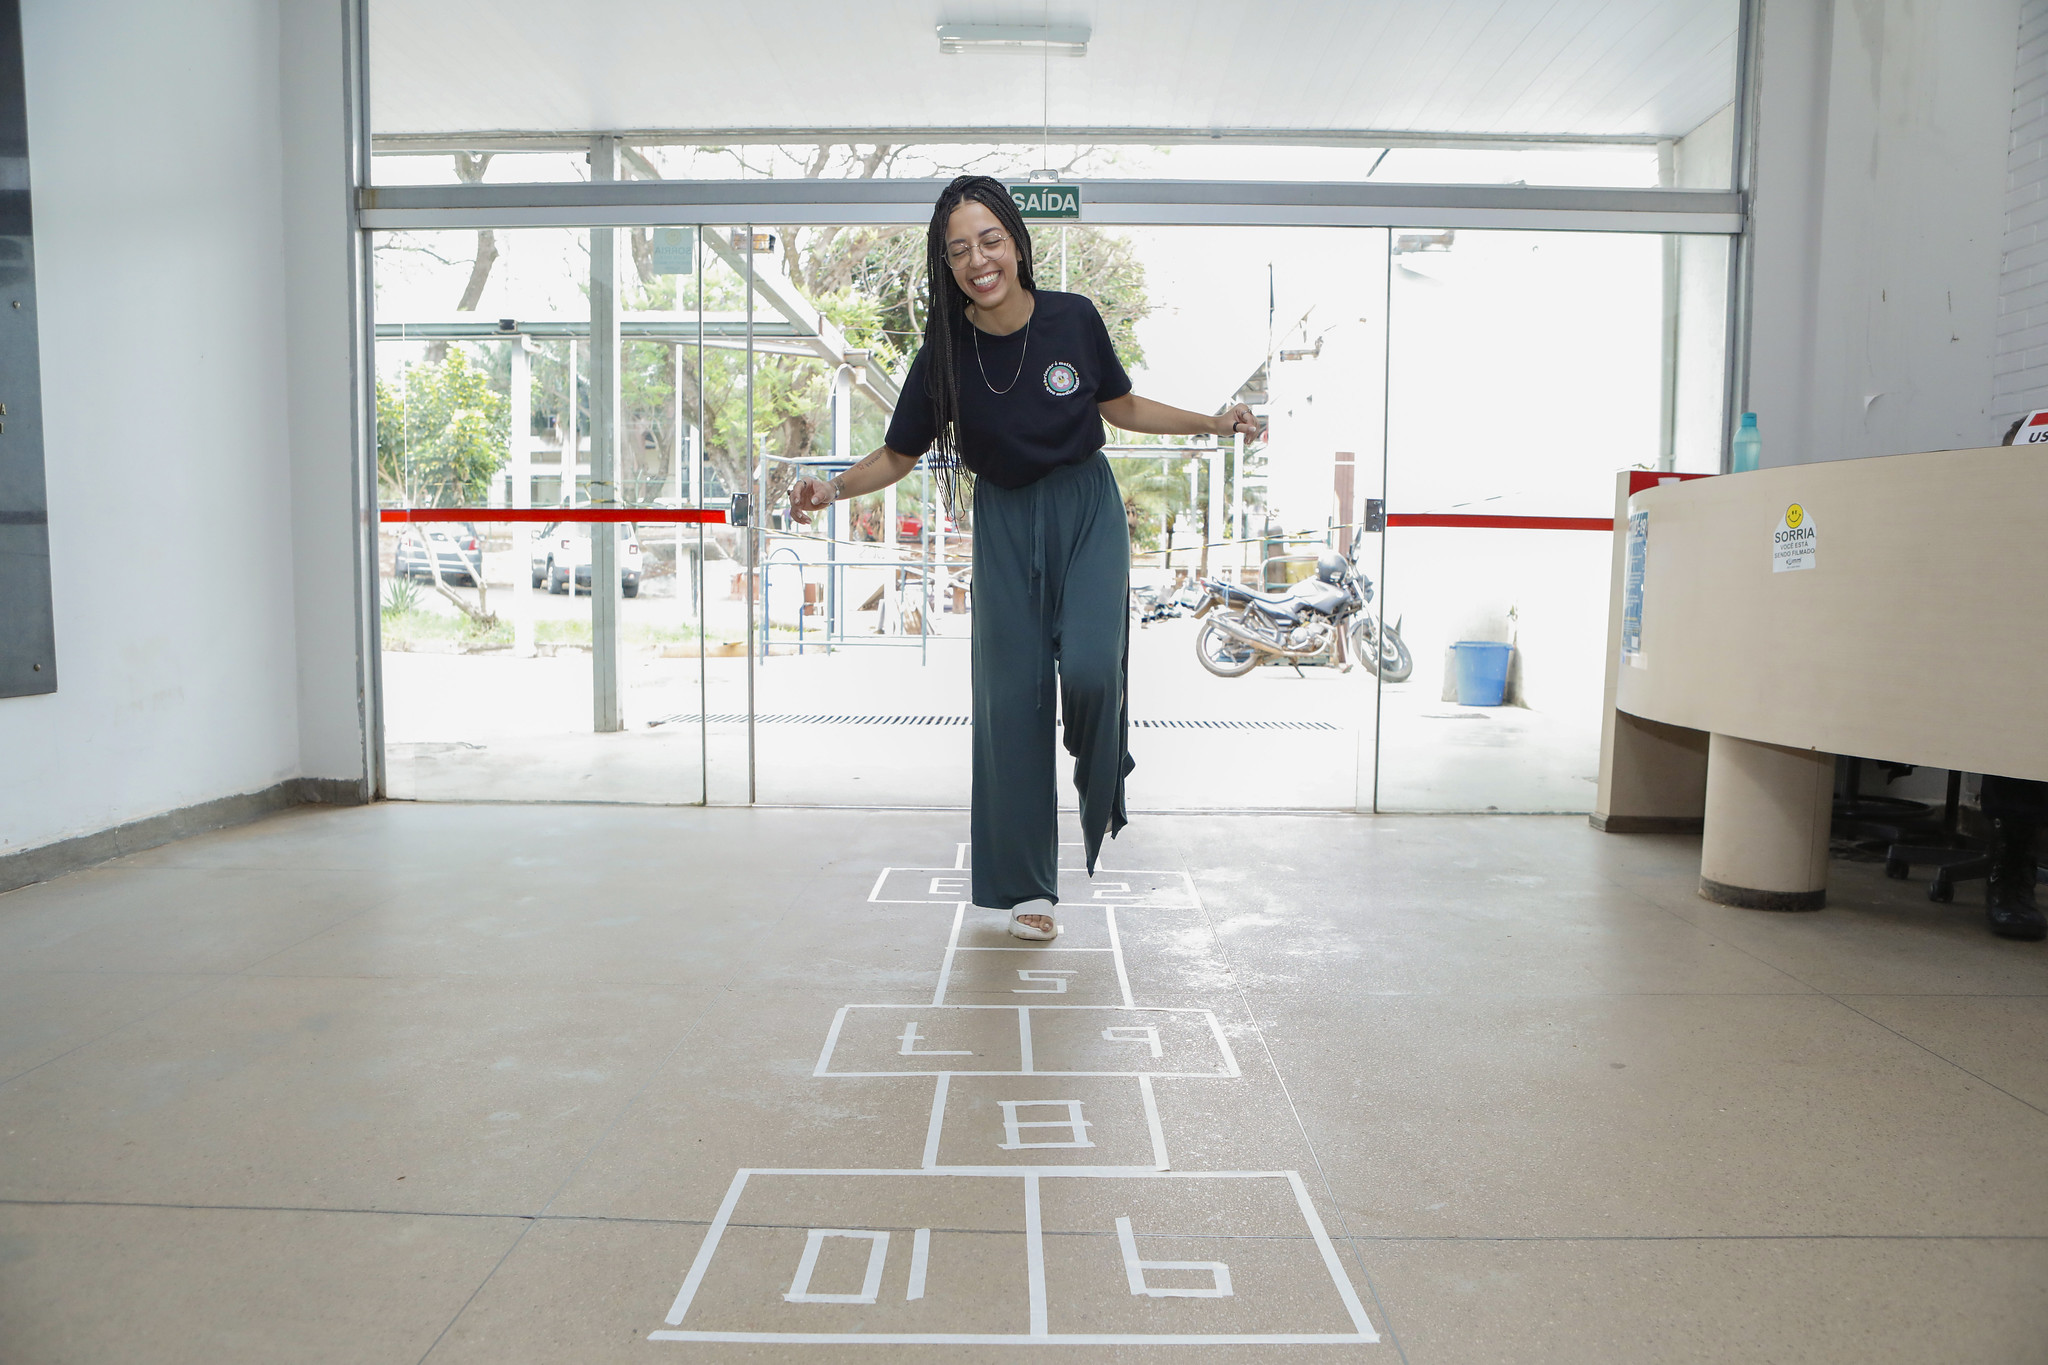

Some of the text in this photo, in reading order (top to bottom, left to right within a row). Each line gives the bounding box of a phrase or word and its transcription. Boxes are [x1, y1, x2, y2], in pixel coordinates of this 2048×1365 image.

[1011, 188, 1078, 212] SAÍDA
[1774, 527, 1814, 543] SORRIA
[1774, 548, 1815, 559] SENDO FILMADO
[996, 1099, 1096, 1150] 8
